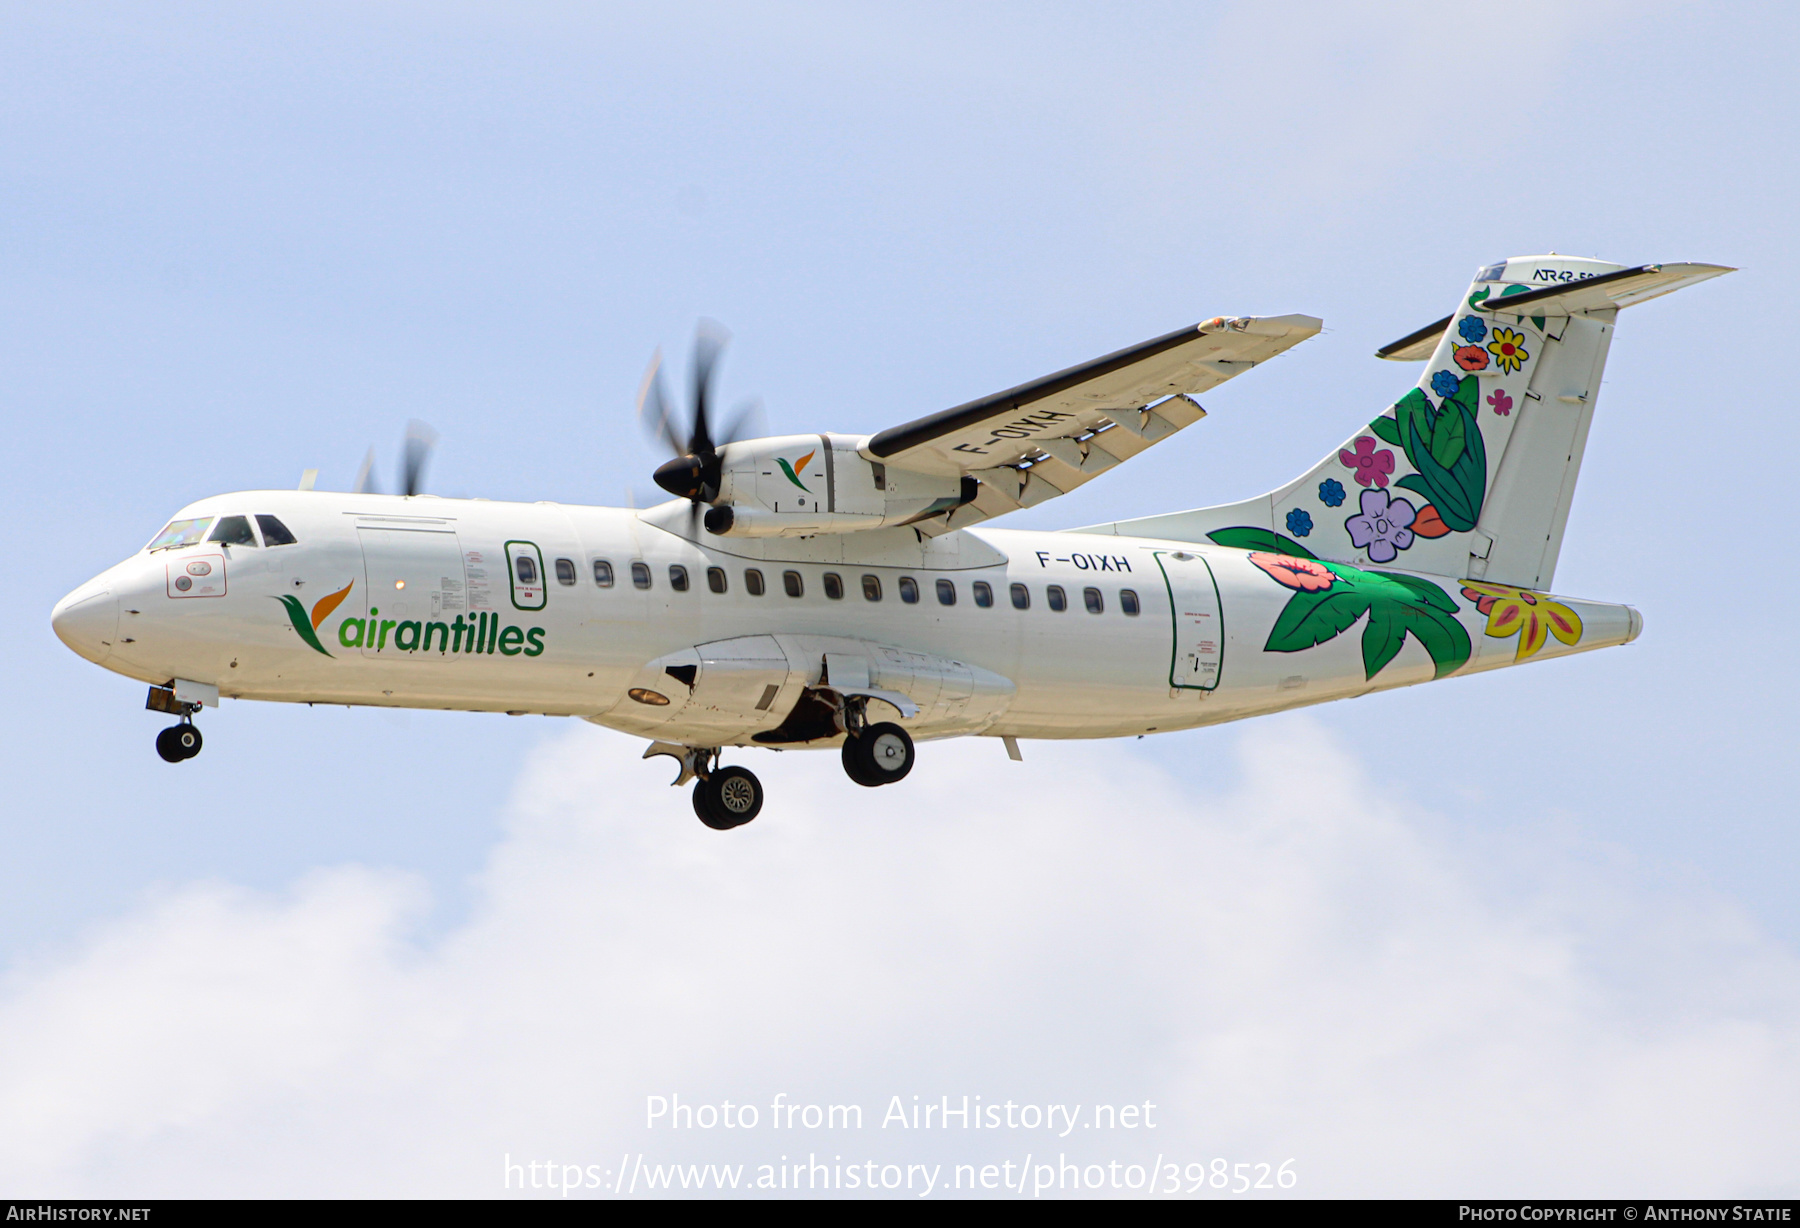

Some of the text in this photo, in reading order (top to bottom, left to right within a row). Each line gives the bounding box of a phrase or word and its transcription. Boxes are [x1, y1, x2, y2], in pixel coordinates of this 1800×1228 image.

[952, 410, 1076, 454] F-OIXH
[1036, 551, 1132, 573] F-OIXH
[338, 607, 546, 657] airantilles
